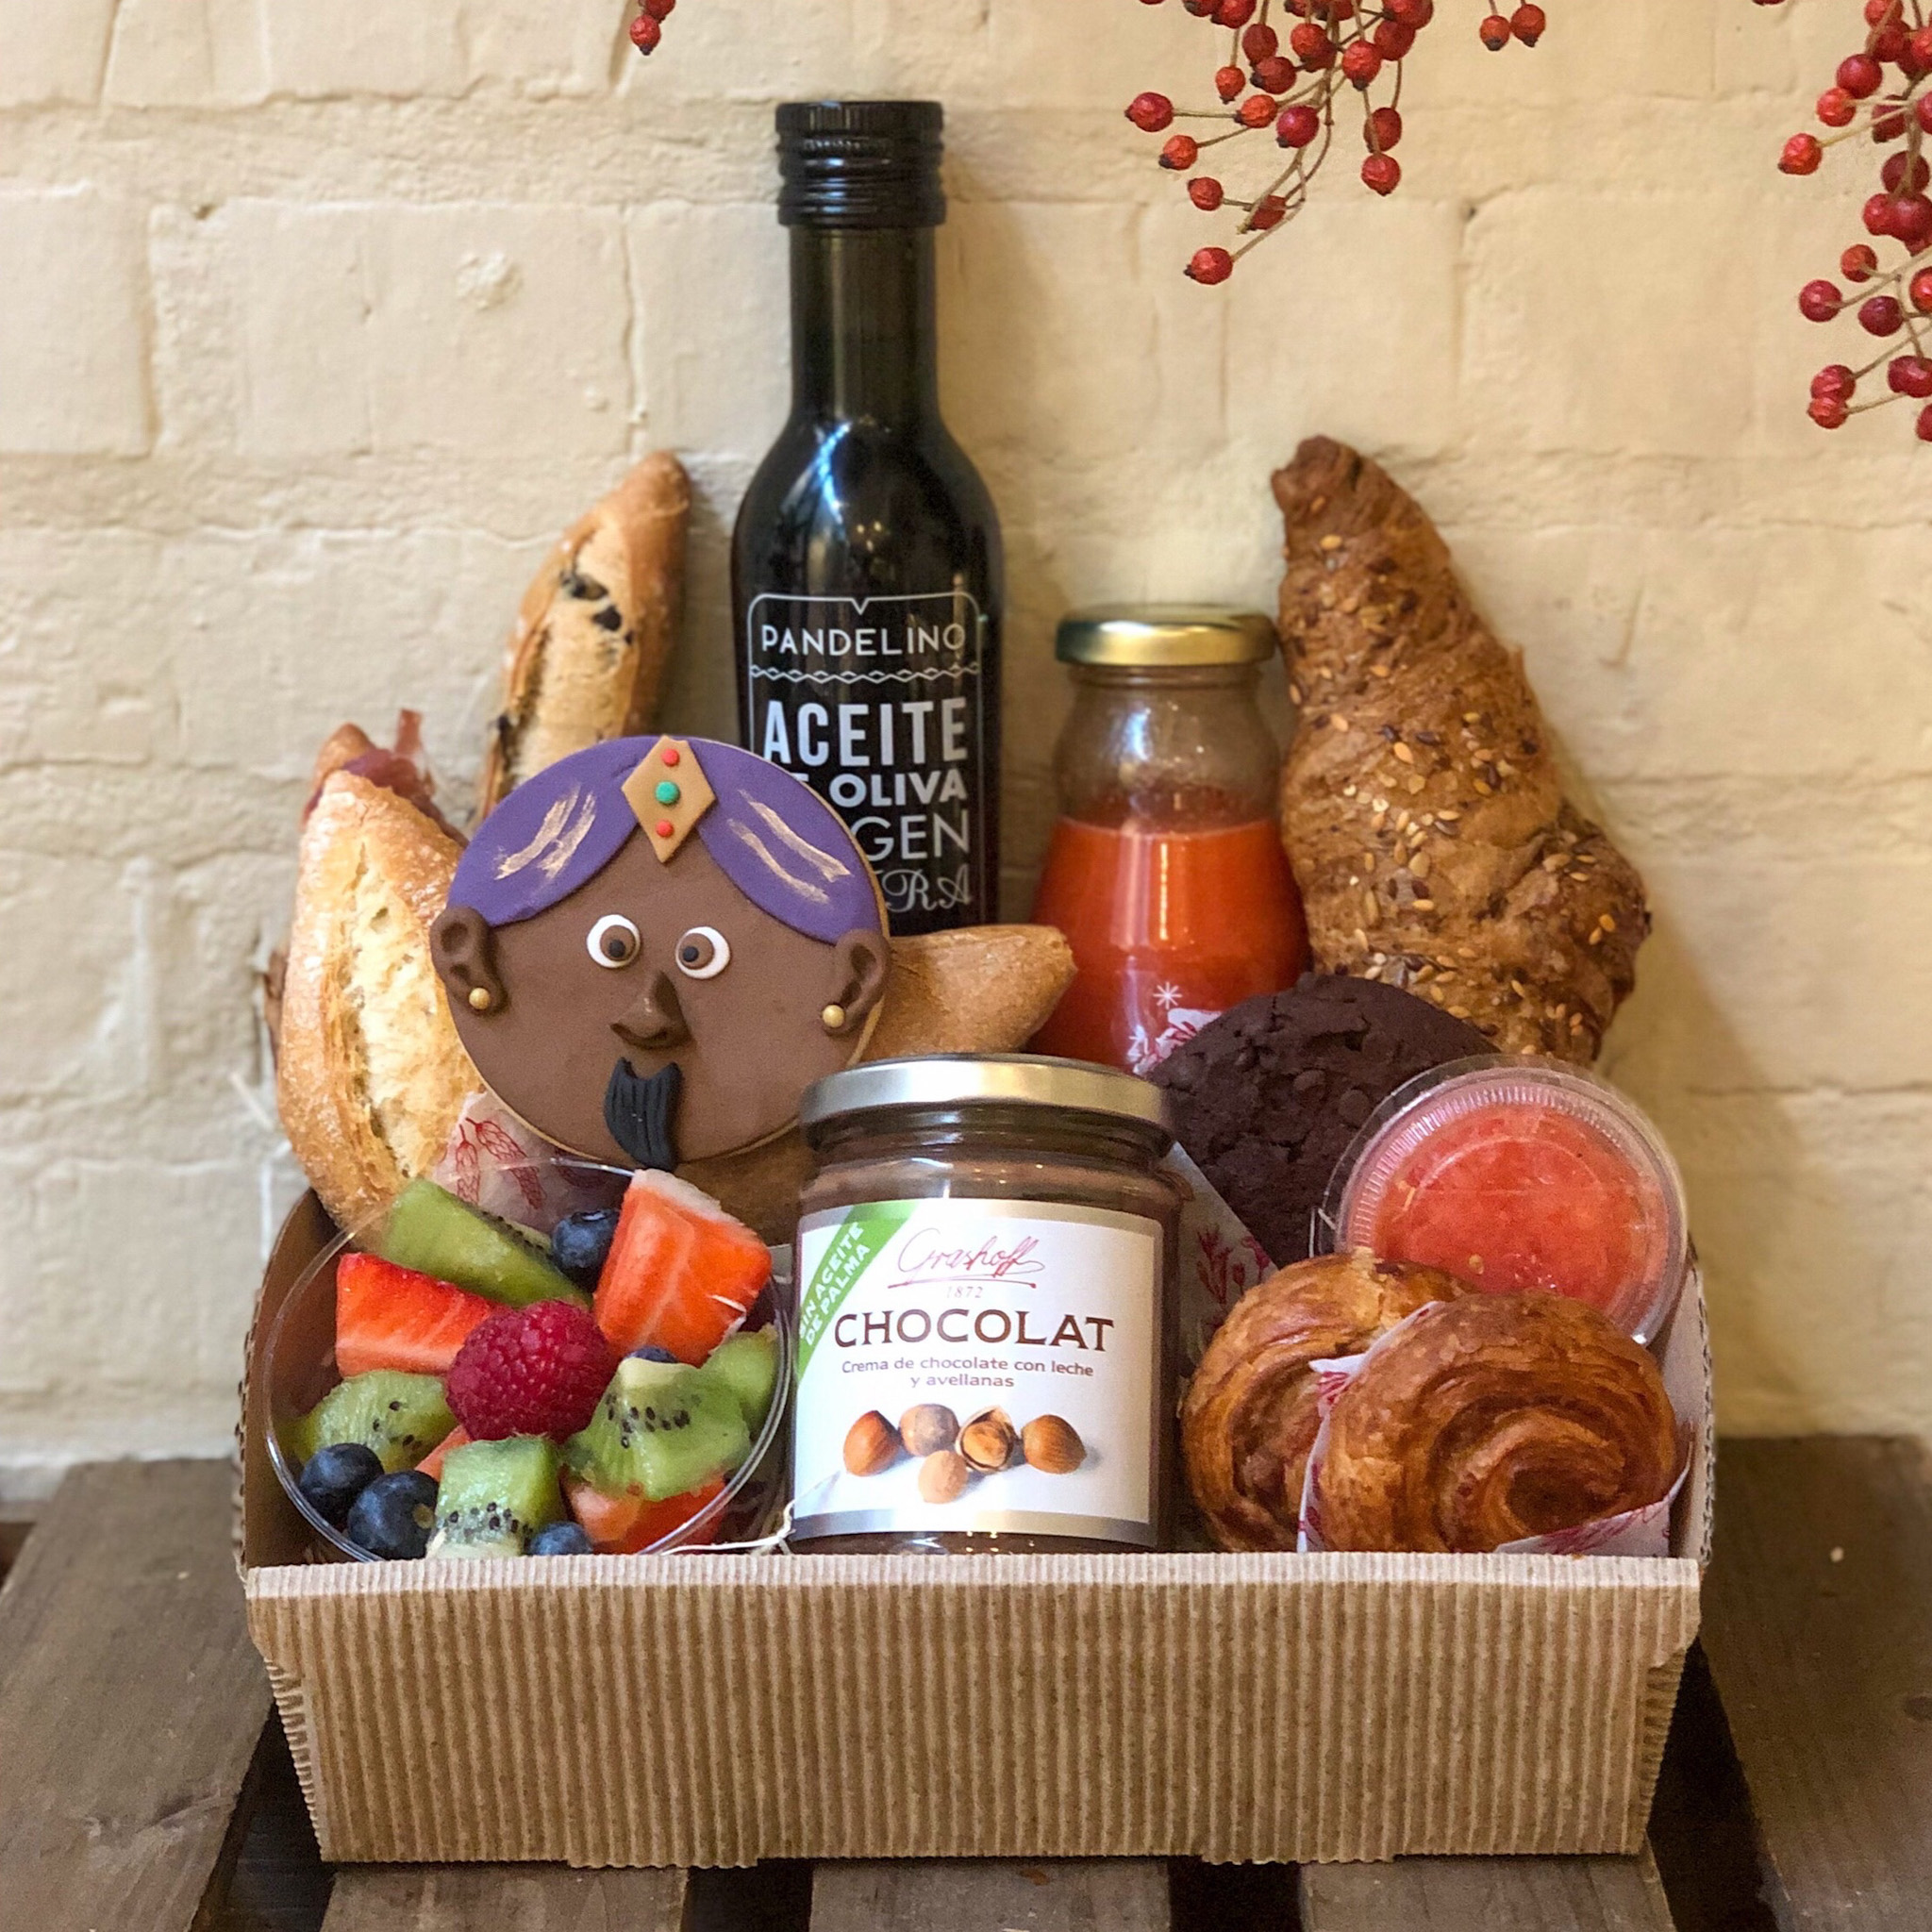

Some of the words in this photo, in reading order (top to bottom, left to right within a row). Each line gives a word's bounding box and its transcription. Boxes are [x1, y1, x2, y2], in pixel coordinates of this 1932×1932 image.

[761, 624, 966, 656] PANDELINO
[763, 697, 968, 766] ACEITE
[829, 769, 968, 808] OLIVA
[851, 809, 970, 861] GEN
[815, 1222, 864, 1300] ACEITE
[806, 1314, 823, 1346] DE
[820, 1244, 871, 1315] PALMA
[946, 1286, 984, 1299] 1872
[834, 1308, 1114, 1352] CHOCOLAT
[841, 1359, 889, 1374] Crema
[894, 1357, 914, 1370] de
[920, 1357, 1008, 1370] chocolate
[1014, 1359, 1045, 1373] con
[1051, 1360, 1094, 1377] leche
[910, 1377, 921, 1389] y
[926, 1374, 1015, 1388] avellanas
